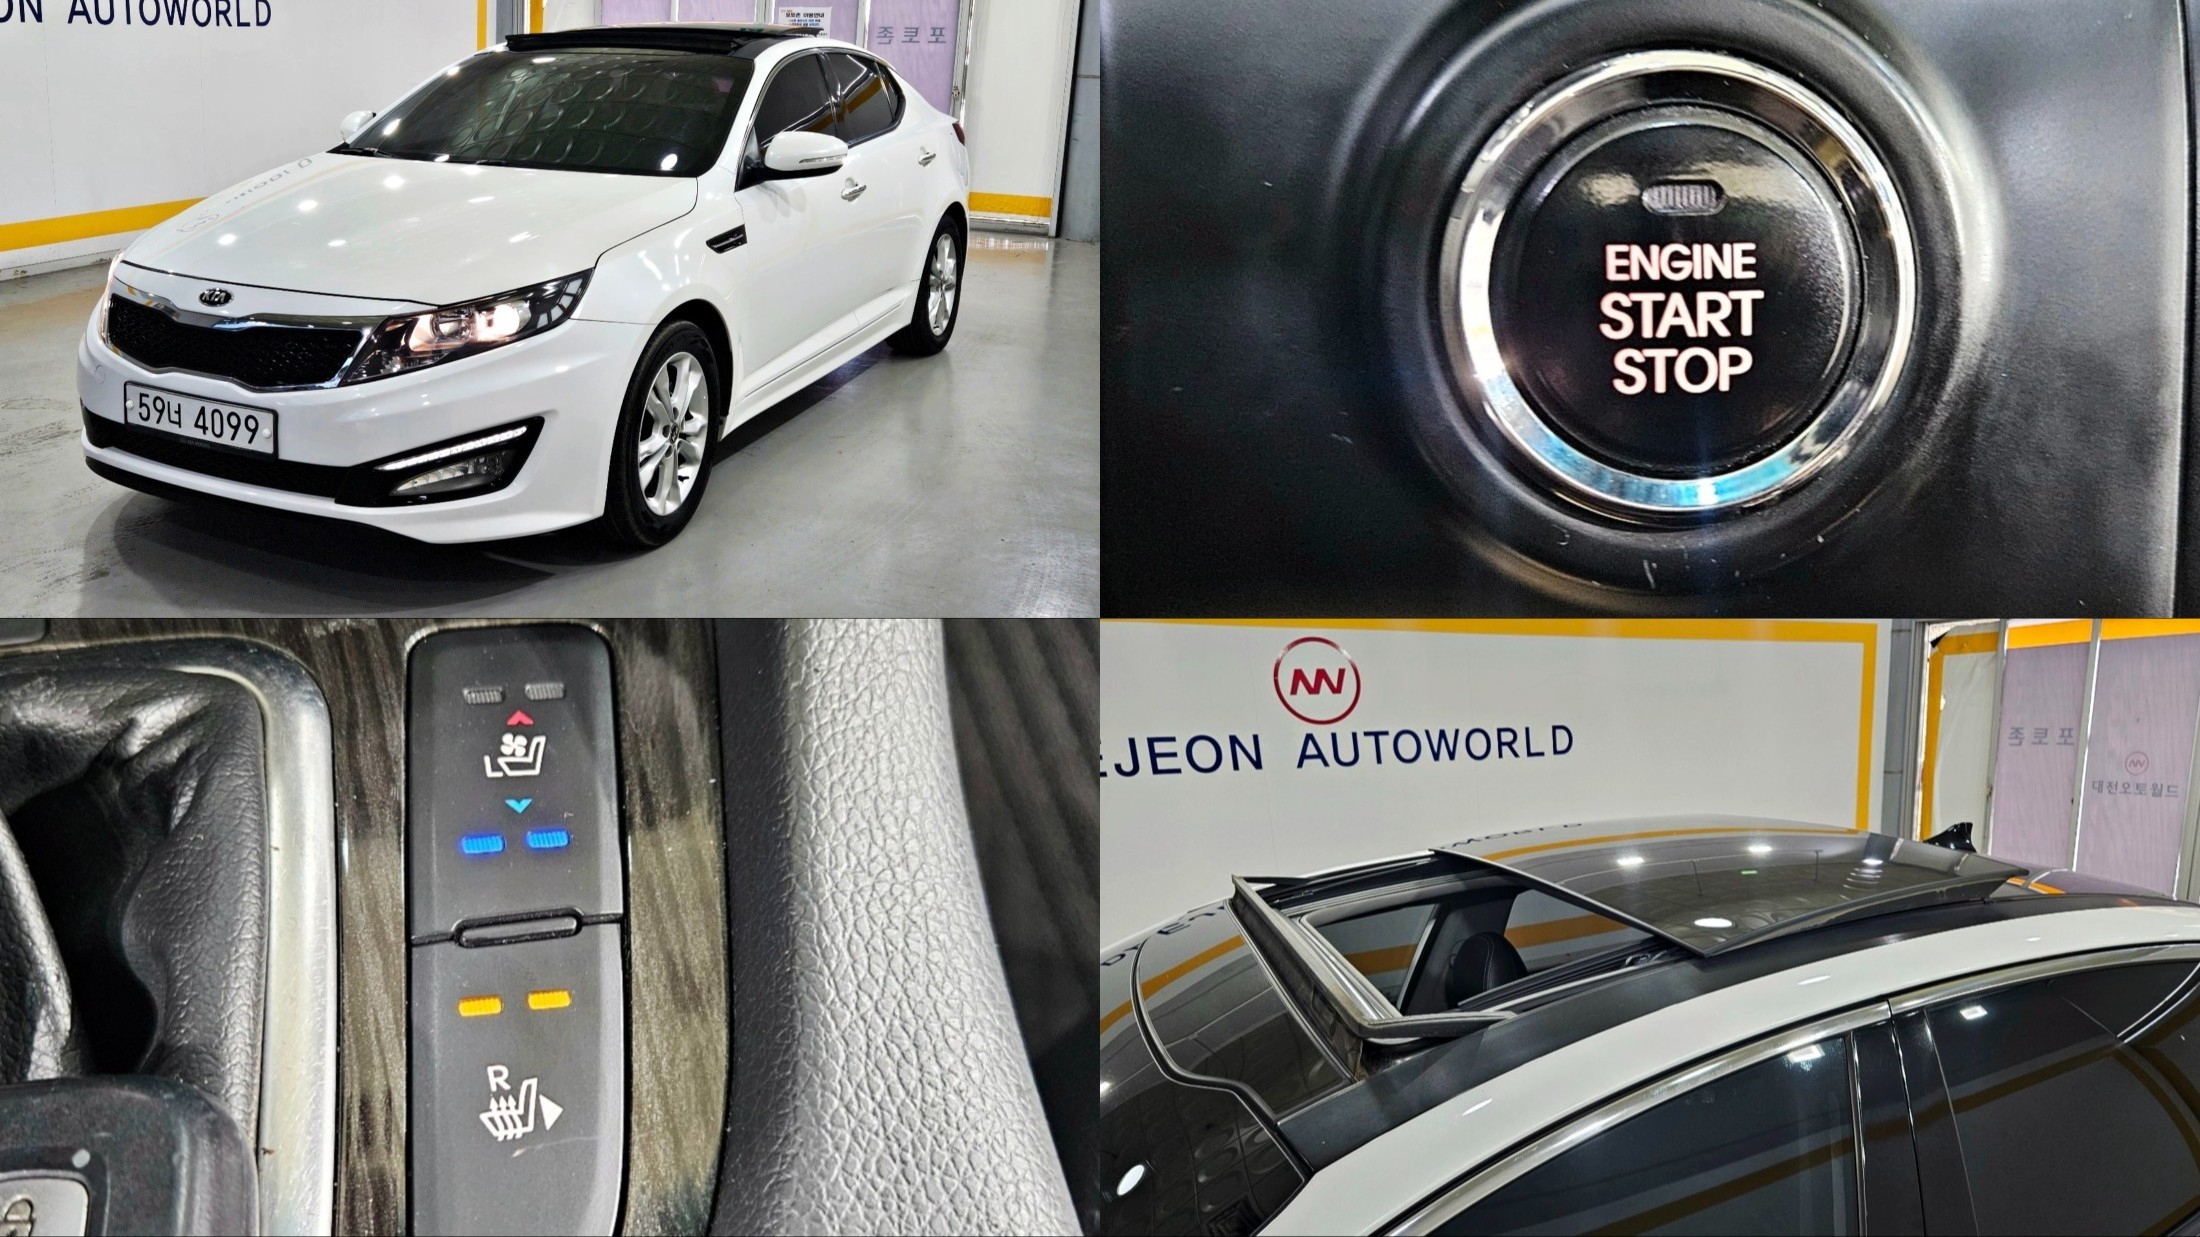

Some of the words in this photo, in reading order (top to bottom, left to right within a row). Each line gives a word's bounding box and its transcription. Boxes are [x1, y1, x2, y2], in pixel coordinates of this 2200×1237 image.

[1605, 242, 1757, 281] ENGINE
[201, 290, 226, 303] KIA
[1599, 289, 1765, 340] START
[1612, 346, 1753, 395] STOP
[138, 392, 182, 428] 59너
[194, 405, 259, 444] 4099
[1100, 734, 1263, 778] JEON
[1296, 724, 1574, 770] AUTOWORLD
[2092, 780, 2179, 798] 대전오토월드
[487, 1064, 511, 1092] R
